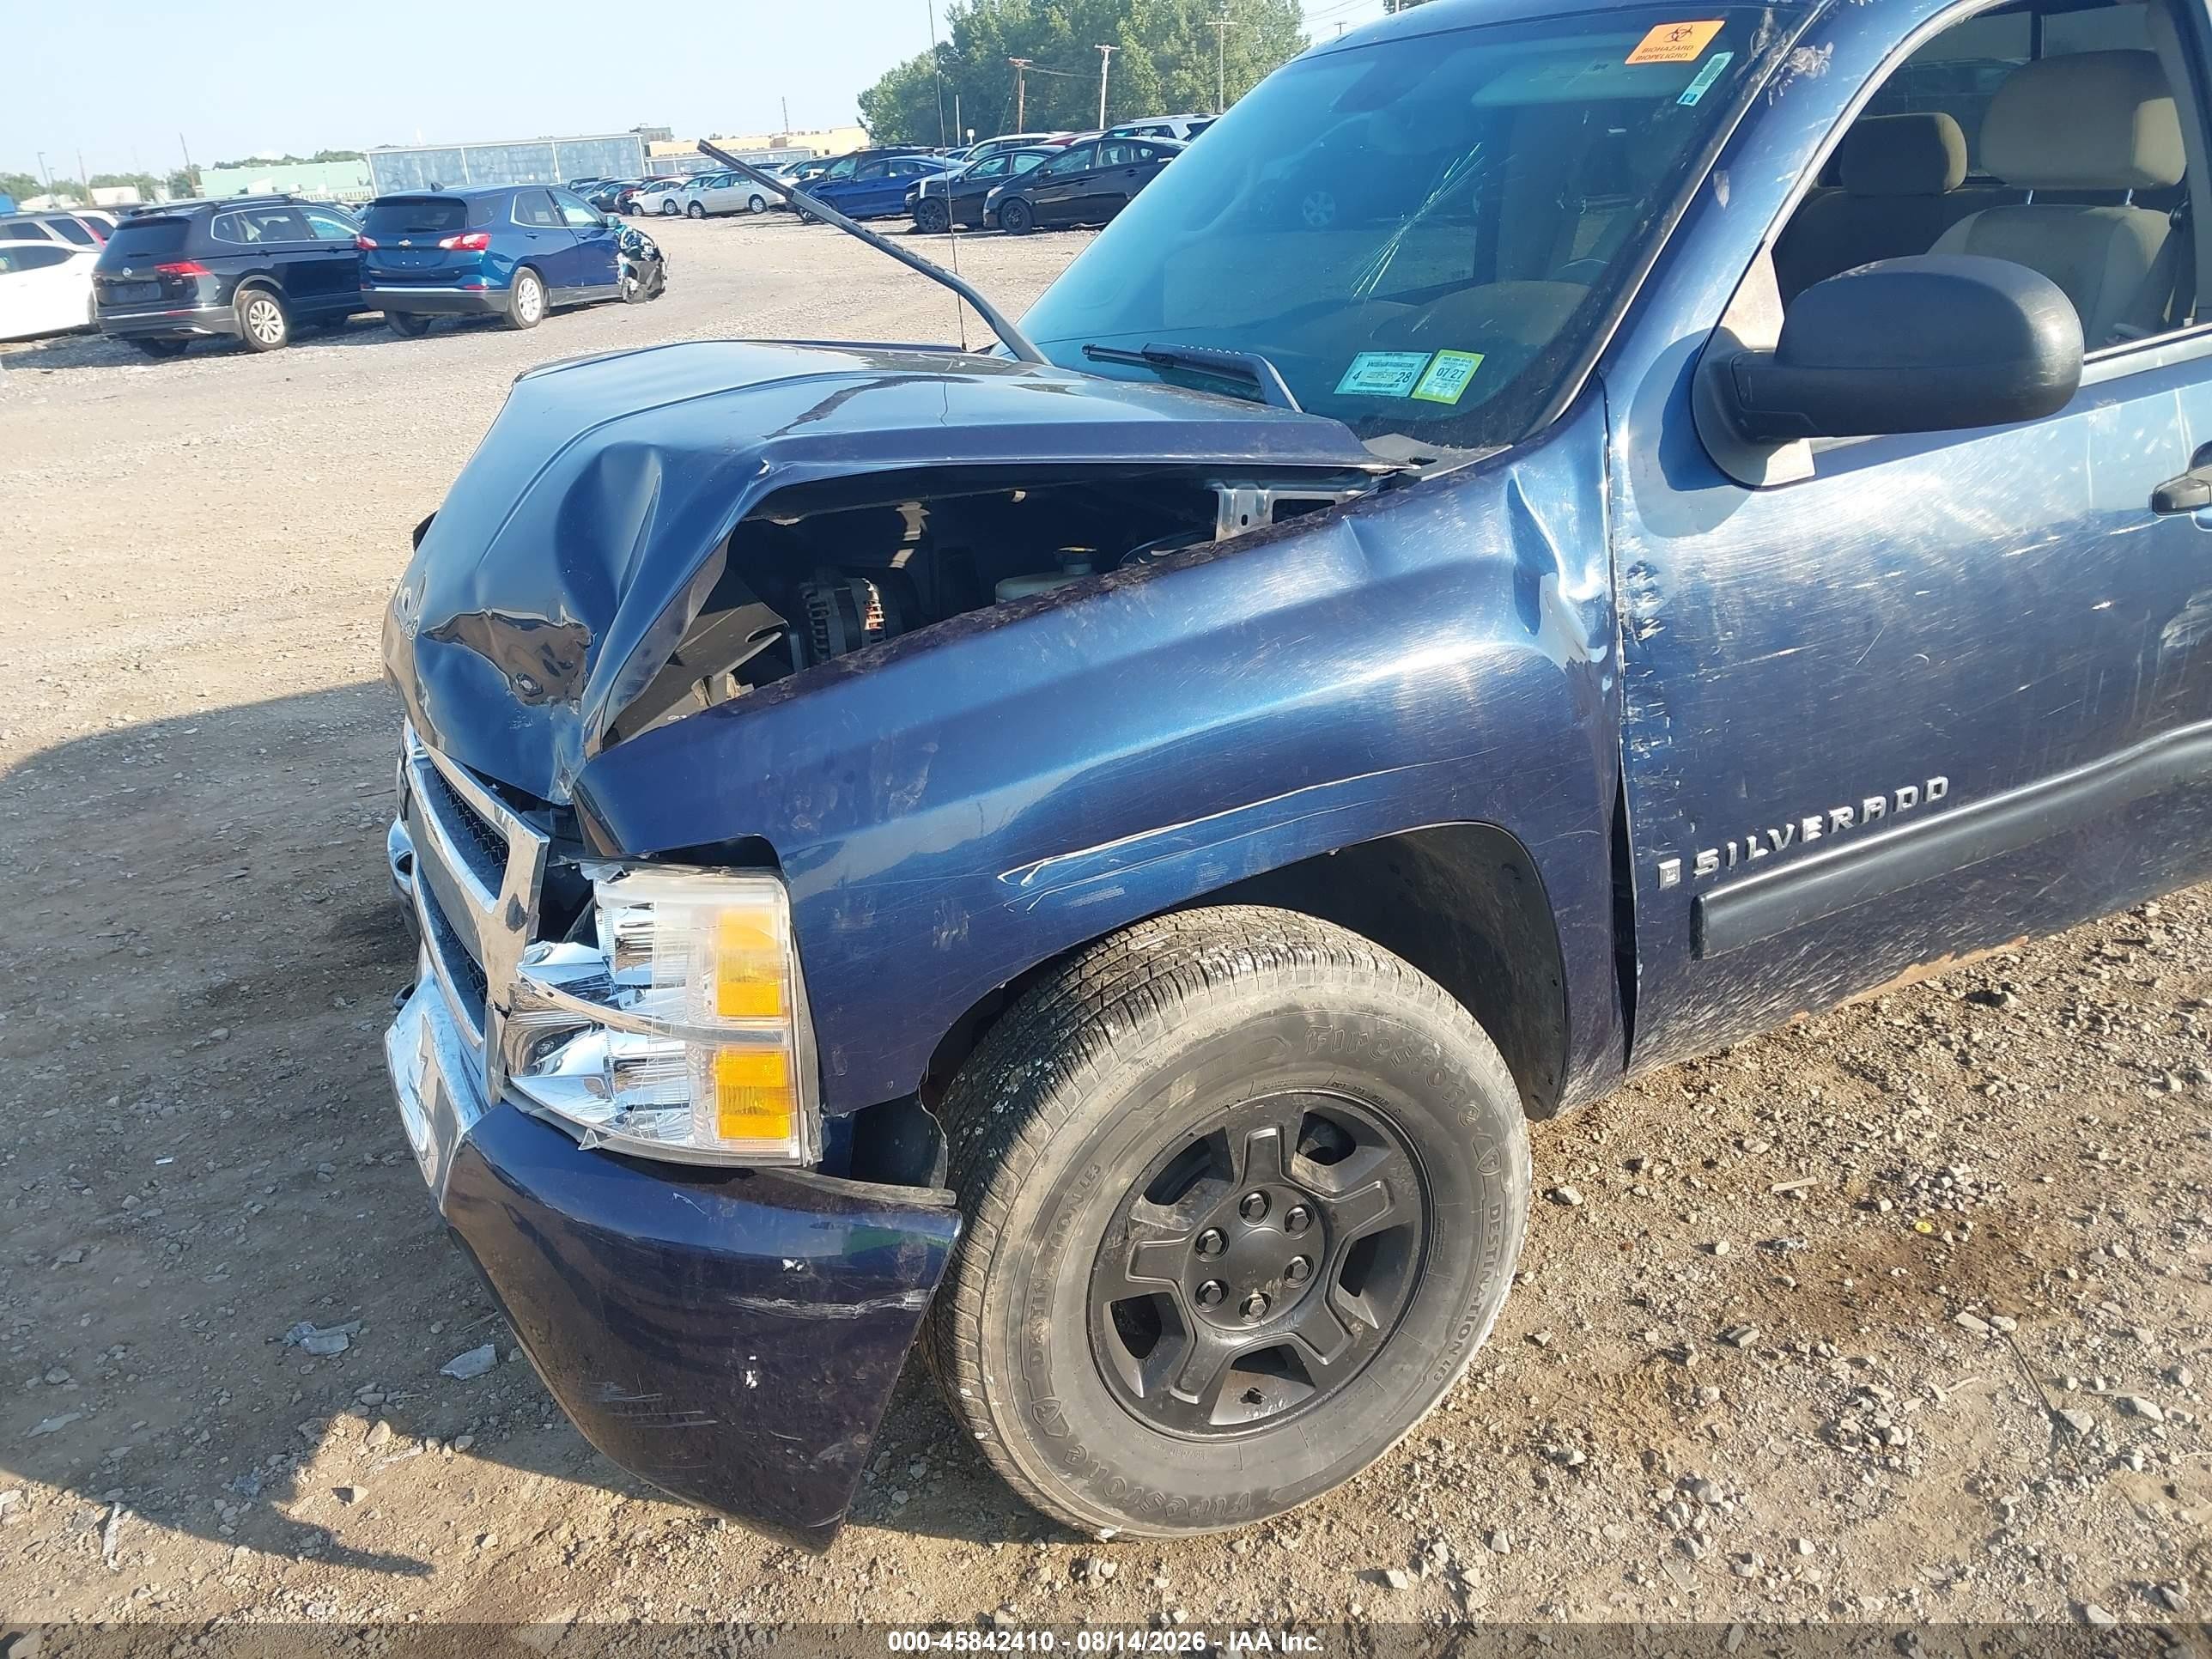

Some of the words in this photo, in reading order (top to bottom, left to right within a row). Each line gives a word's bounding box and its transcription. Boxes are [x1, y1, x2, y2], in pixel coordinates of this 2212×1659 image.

[1641, 45, 1694, 53] BIOHAZARD
[1635, 52, 1688, 61] BIOPELIGRO
[1352, 370, 1362, 381] 4
[1394, 371, 1413, 384] 28
[1436, 367, 1450, 378] 07
[1450, 368, 1466, 380] 27
[1693, 775, 1950, 878] SILVERADO
[1079, 1163, 1103, 1191] LE3
[1448, 1202, 1502, 1358] DESTINATION
[1433, 1359, 1453, 1382] LE3
